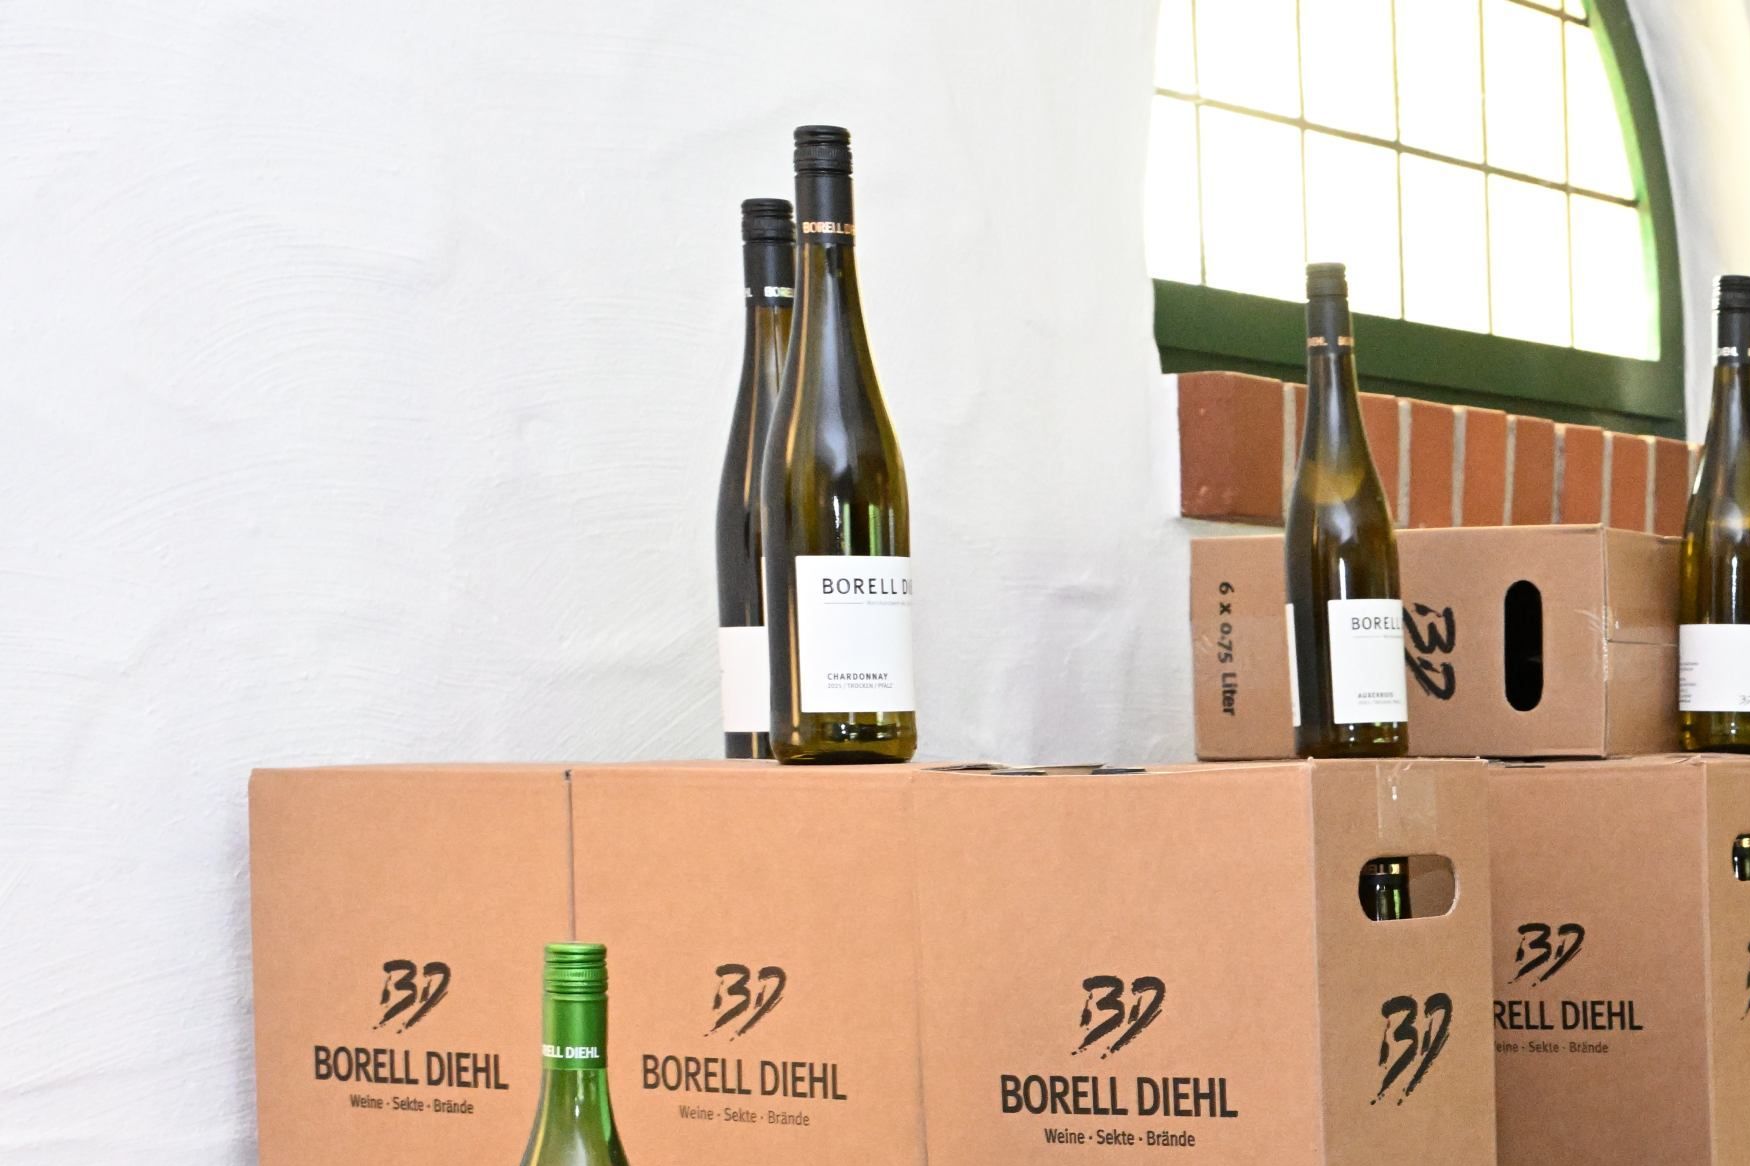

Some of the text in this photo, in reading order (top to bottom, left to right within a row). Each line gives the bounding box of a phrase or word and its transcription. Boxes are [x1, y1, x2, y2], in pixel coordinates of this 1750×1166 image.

[822, 578, 898, 595] BORELL
[1218, 581, 1236, 595] 6
[1219, 602, 1233, 616] x
[827, 673, 889, 681] CHARDONNAY
[1220, 672, 1239, 717] Liter
[1562, 1000, 1643, 1032] DIEHL
[565, 1046, 600, 1058] DIEHL
[1528, 1040, 1561, 1053] Sekte
[1568, 1039, 1609, 1054] Brände
[313, 1045, 510, 1091] BORELL DIEHL
[641, 1054, 848, 1101] BORELL DIEHL
[350, 1094, 474, 1115] Weine Sekte Brände
[1000, 1074, 1239, 1118] BORELL DIEHL
[679, 1104, 810, 1127] Weine Sekte Brände
[1044, 1128, 1196, 1147] Weine Sekte Brände
